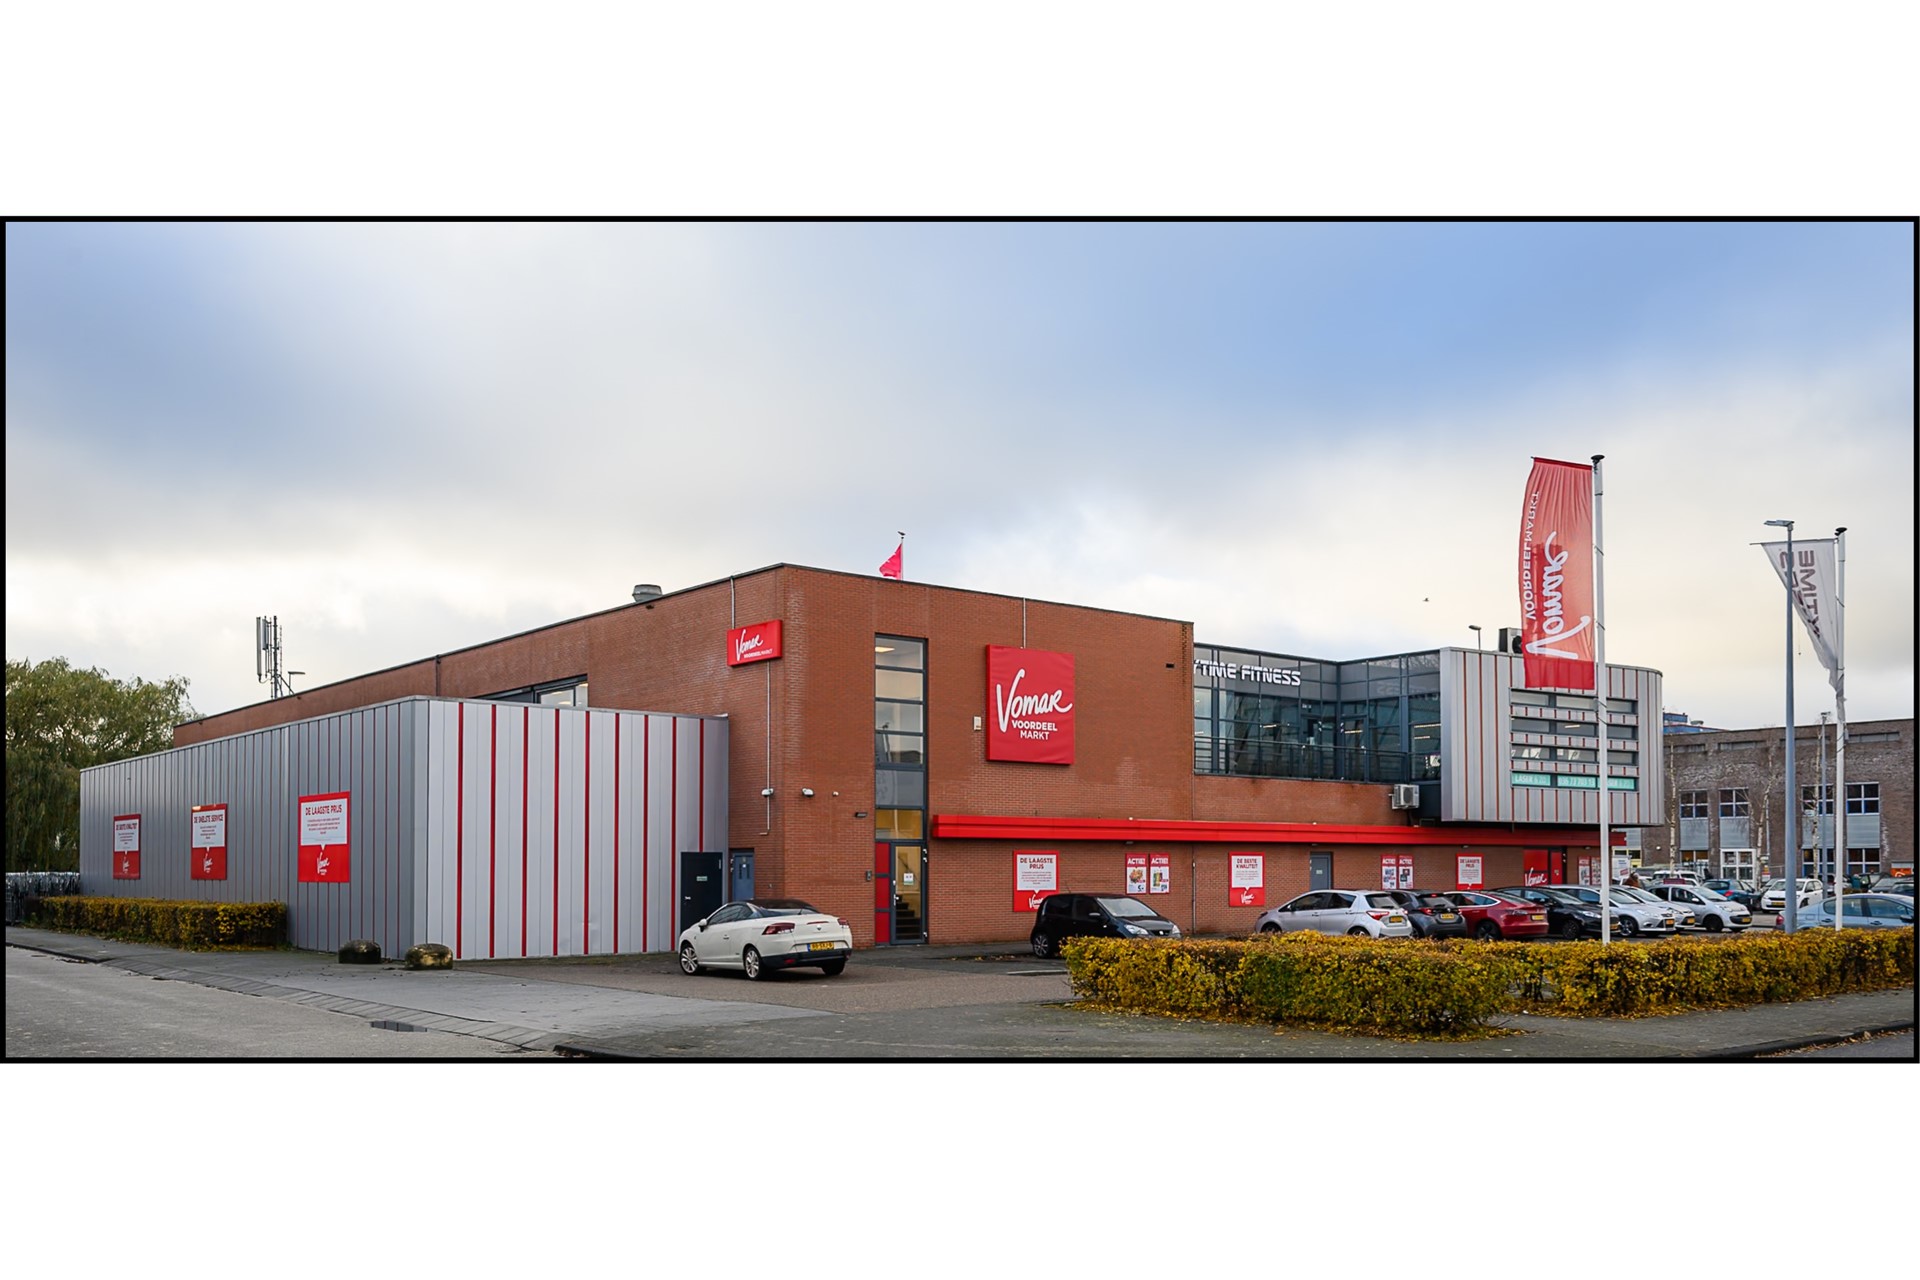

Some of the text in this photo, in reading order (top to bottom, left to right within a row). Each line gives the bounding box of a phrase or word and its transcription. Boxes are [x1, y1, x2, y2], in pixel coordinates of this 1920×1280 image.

[736, 629, 764, 661] Vomar
[1241, 664, 1301, 686] FITNESS
[996, 668, 1073, 733] Vomar
[1011, 719, 1058, 731] VOORDEEL
[1020, 730, 1050, 740] MARKT
